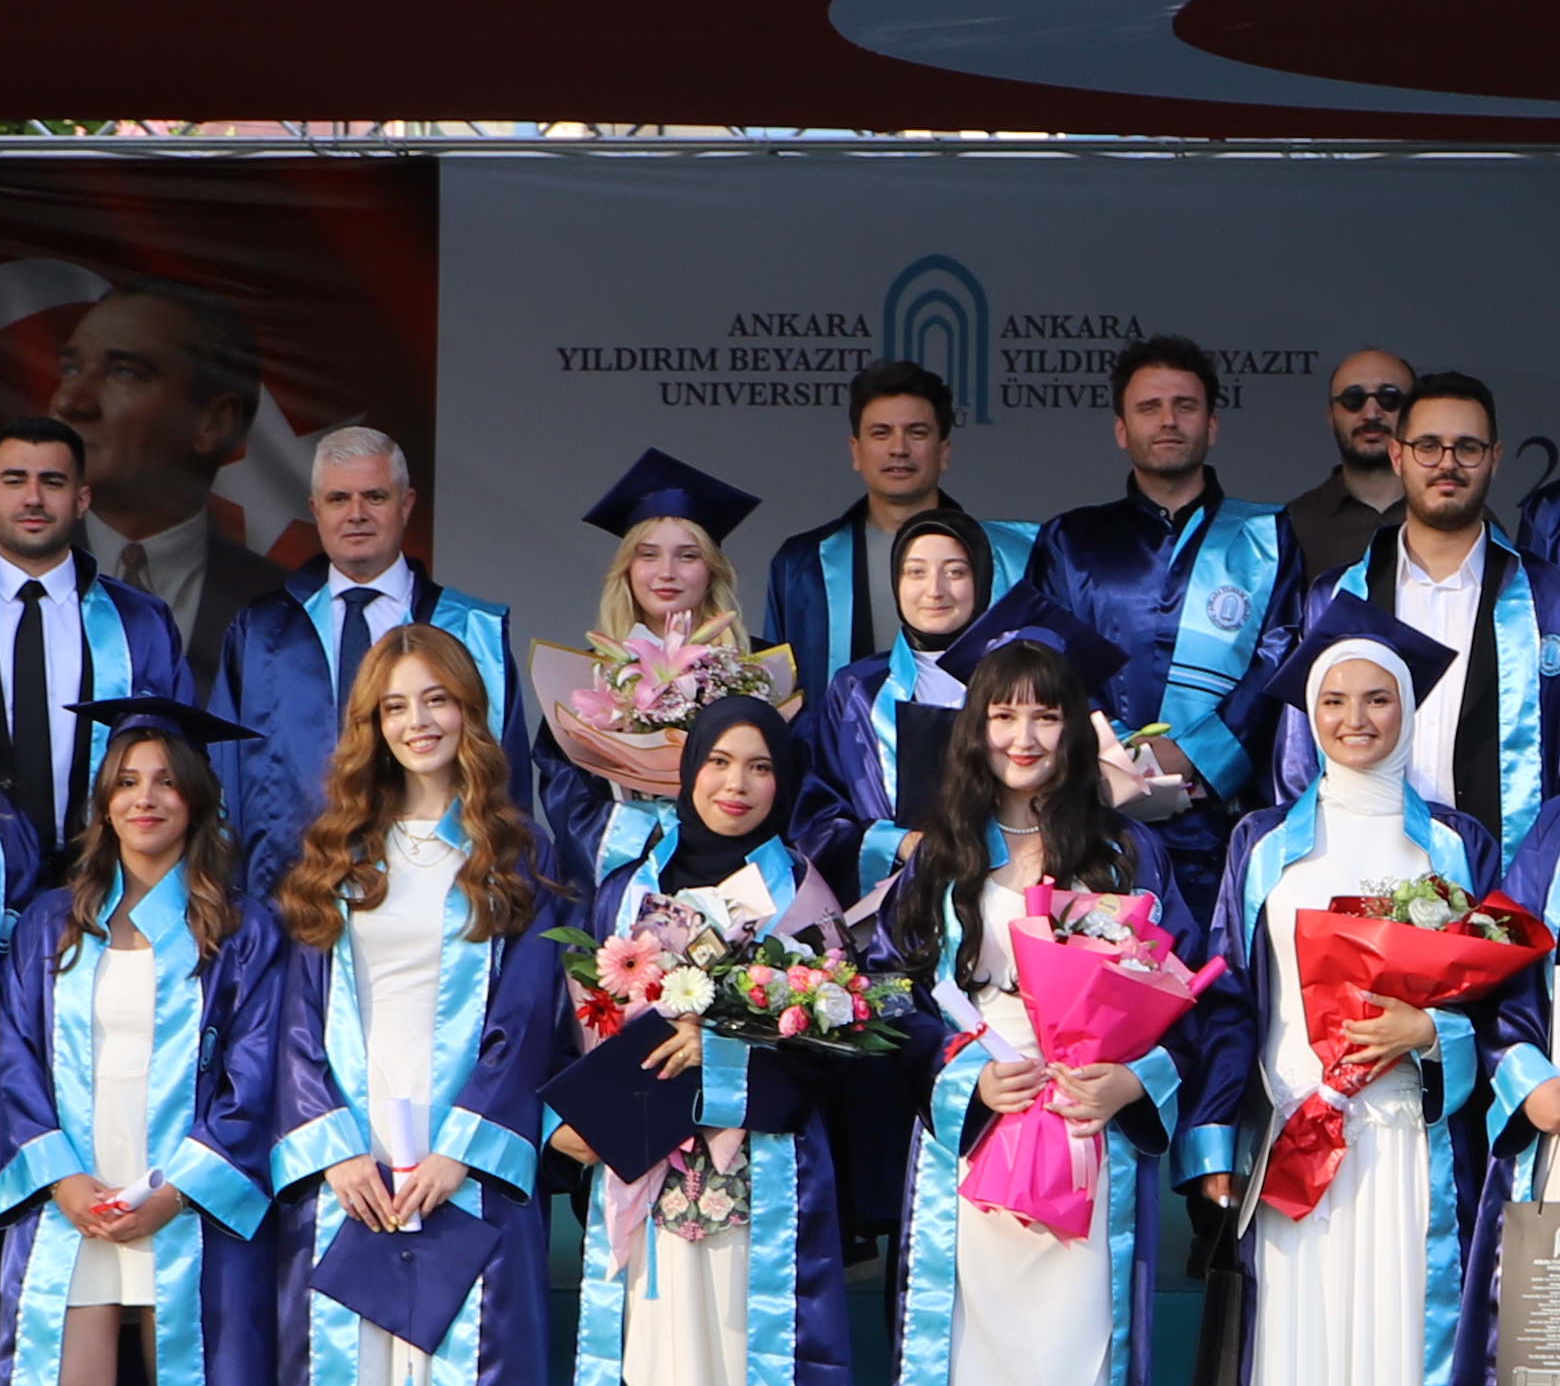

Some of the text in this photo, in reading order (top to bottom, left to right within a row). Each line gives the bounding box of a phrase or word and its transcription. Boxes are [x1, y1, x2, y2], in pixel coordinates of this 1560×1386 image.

[728, 313, 872, 338] ANKARA
[1000, 314, 1145, 339] ANKARA
[557, 347, 872, 372] YILDIRIM BEYAZIT
[1000, 349, 1119, 375] YILDIR
[660, 381, 852, 407] UNIVERSIT
